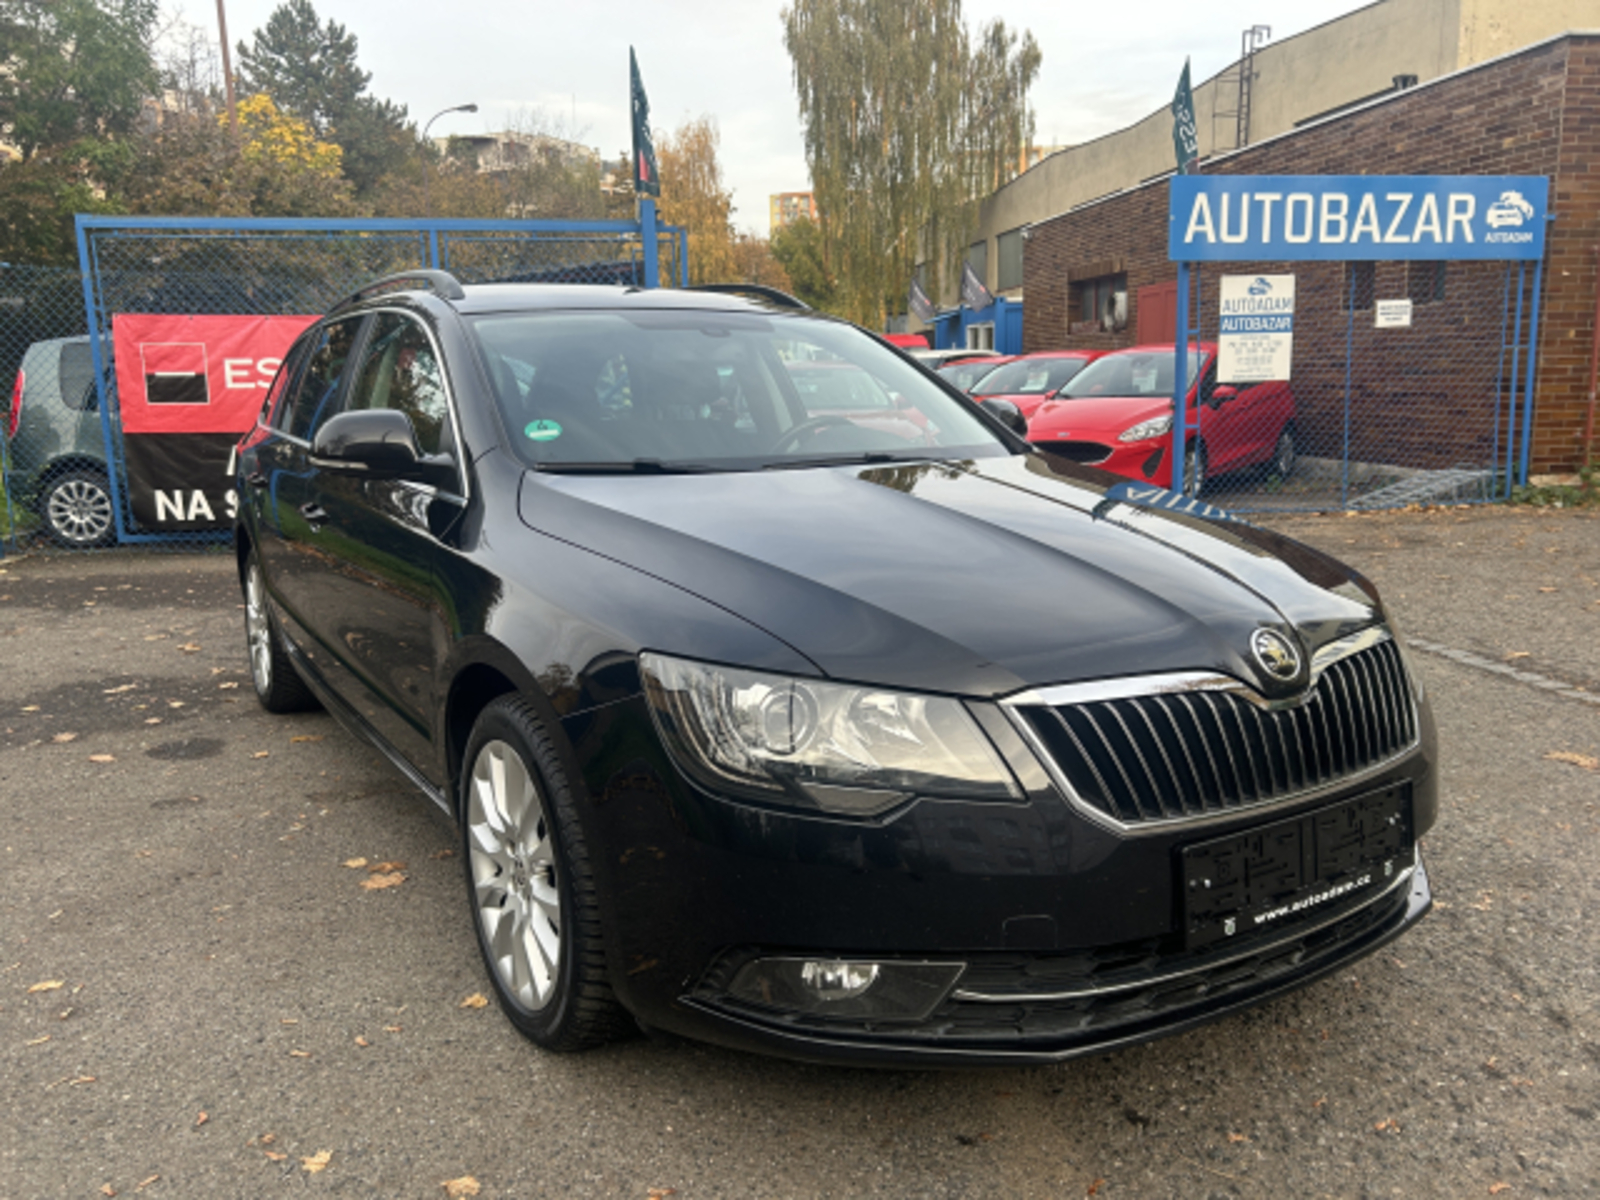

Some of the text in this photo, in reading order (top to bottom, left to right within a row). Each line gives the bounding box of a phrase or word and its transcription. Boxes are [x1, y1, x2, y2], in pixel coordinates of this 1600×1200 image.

[1184, 192, 1476, 244] AUTOBAZAR
[1222, 297, 1293, 313] AUTOADAM
[1221, 316, 1291, 331] AUTOBAZAR
[154, 489, 215, 522] NA
